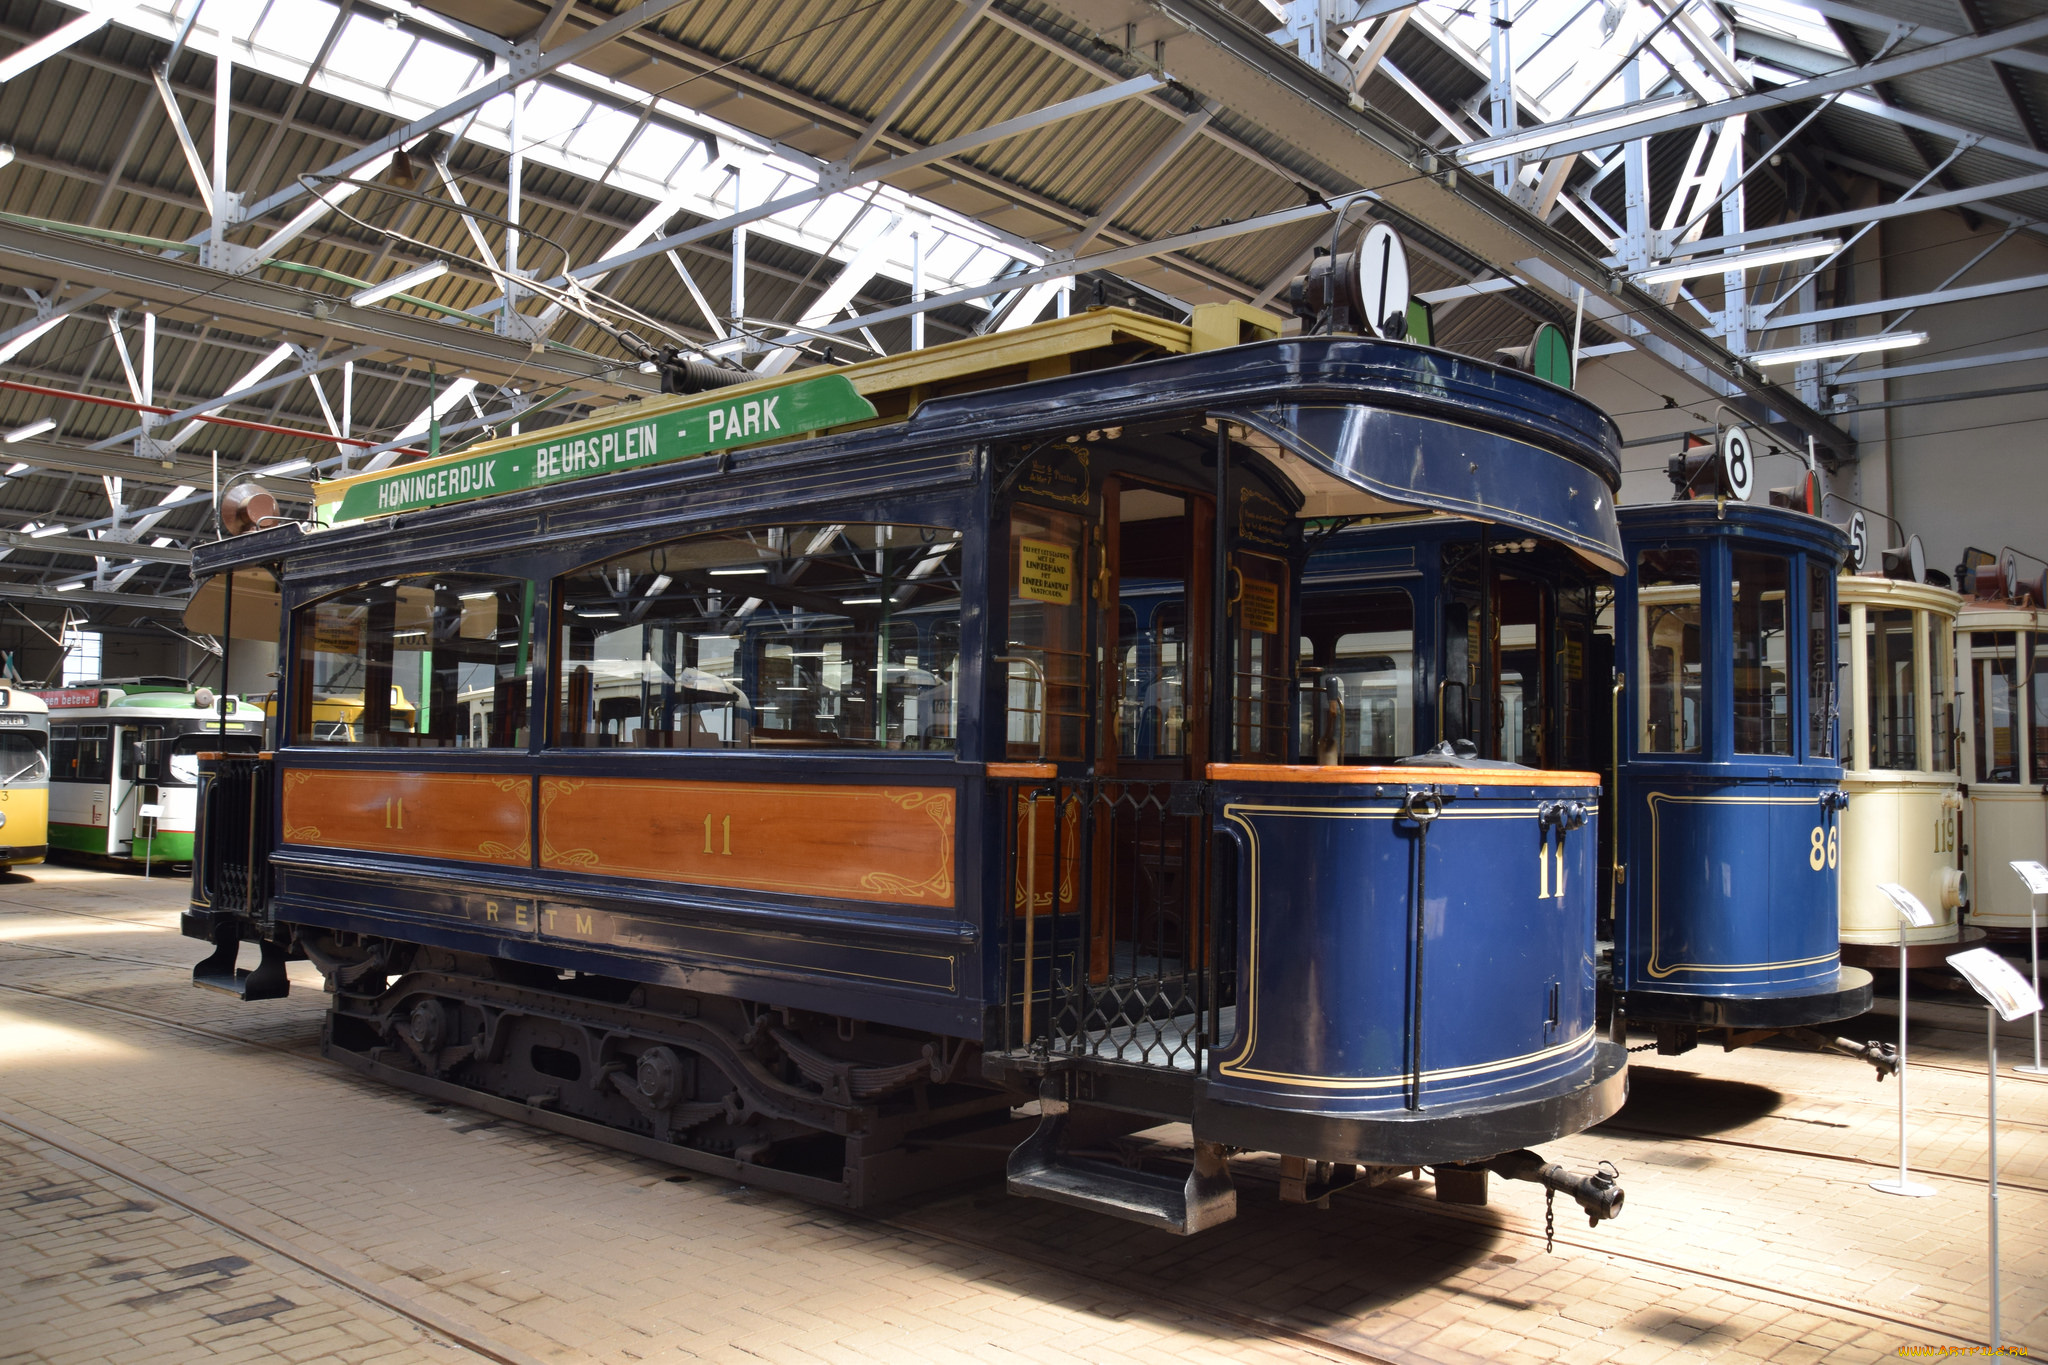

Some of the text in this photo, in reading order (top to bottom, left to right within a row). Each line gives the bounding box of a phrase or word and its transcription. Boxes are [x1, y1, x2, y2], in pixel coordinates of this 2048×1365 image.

[1376, 233, 1391, 331] 1
[378, 460, 496, 509] HONINGERDIJK
[537, 424, 657, 479] BEURSPLEIN
[709, 396, 781, 443] PARK
[1730, 437, 1747, 489] 8
[1853, 518, 1865, 566] 5
[1026, 560, 1065, 574] LINKERHAND
[42, 692, 96, 706] een betere!
[385, 796, 404, 829] 11
[703, 813, 733, 855] 11
[1934, 817, 1955, 853] 119
[1538, 841, 1565, 899] 11
[1809, 825, 1837, 872] 86
